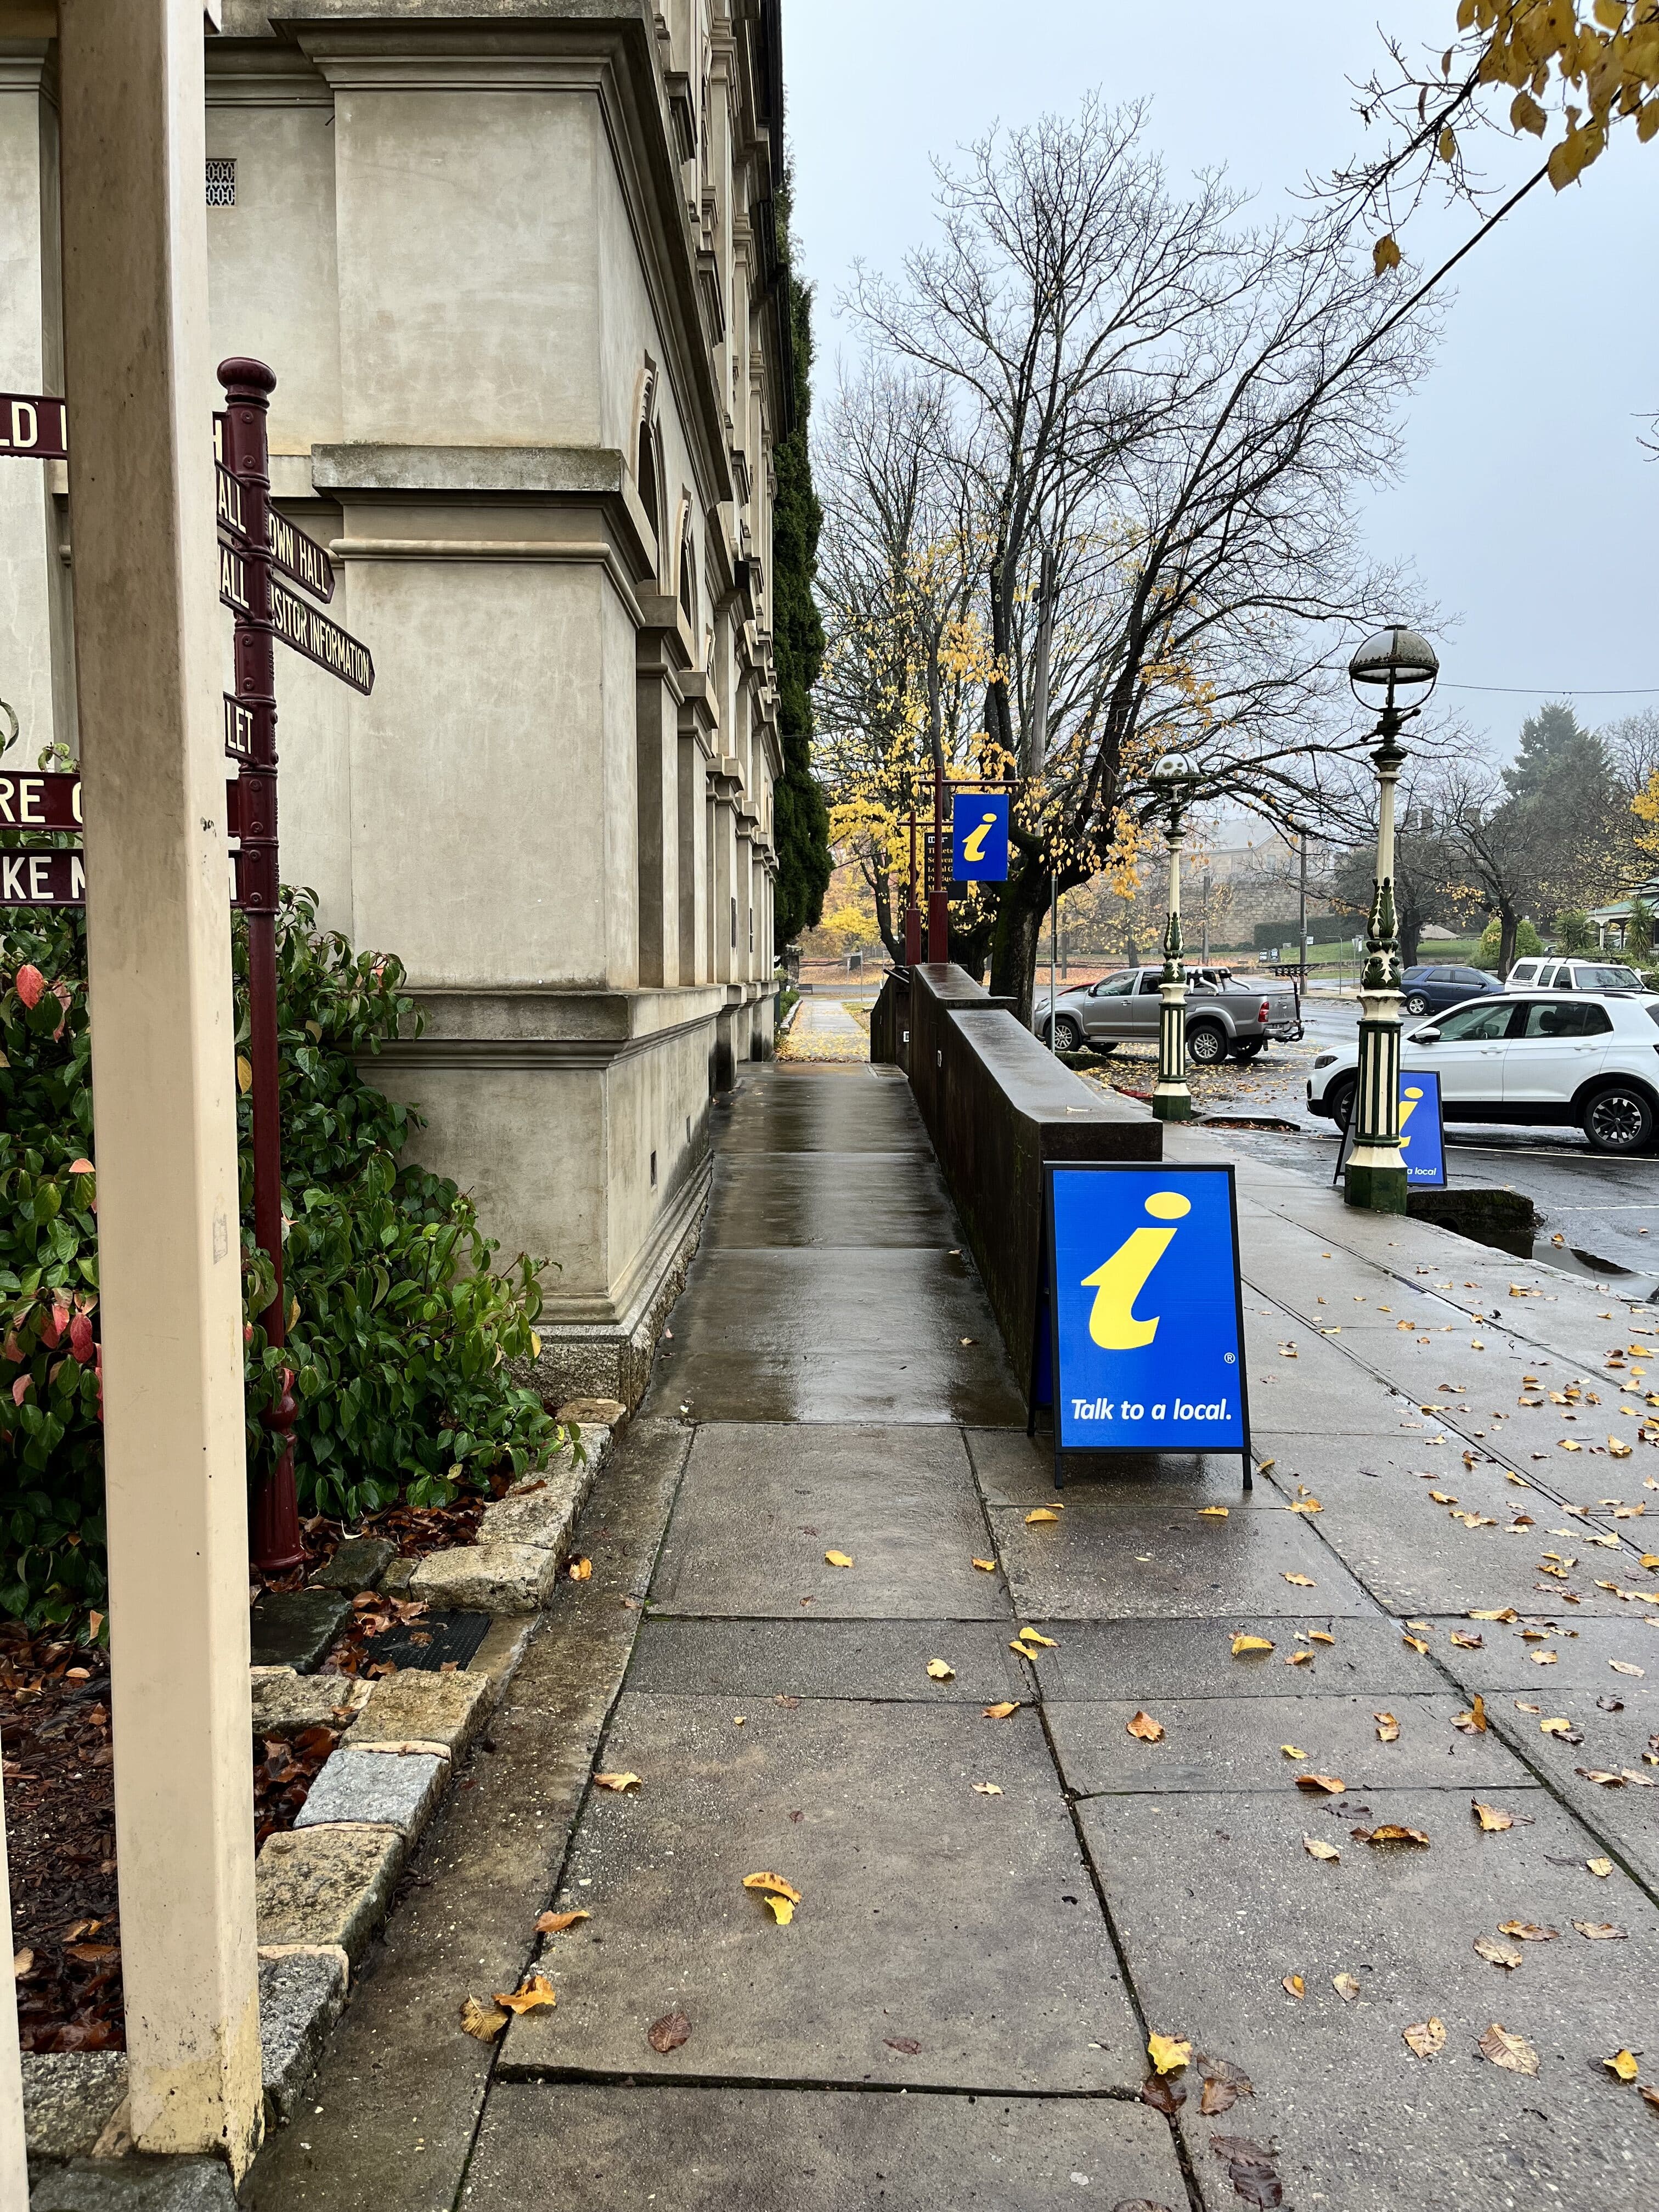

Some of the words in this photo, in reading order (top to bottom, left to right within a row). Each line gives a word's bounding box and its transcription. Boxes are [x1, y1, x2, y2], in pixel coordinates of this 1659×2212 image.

[218, 545, 249, 609] ALL
[299, 535, 328, 595] HALL
[310, 612, 369, 689] INFORMATION
[227, 701, 253, 754] LET
[1415, 1167, 1437, 1176] local
[1071, 1397, 1114, 1420] Talk
[1120, 1400, 1144, 1420] to
[1151, 1403, 1166, 1420] a
[1172, 1398, 1232, 1420] local.
